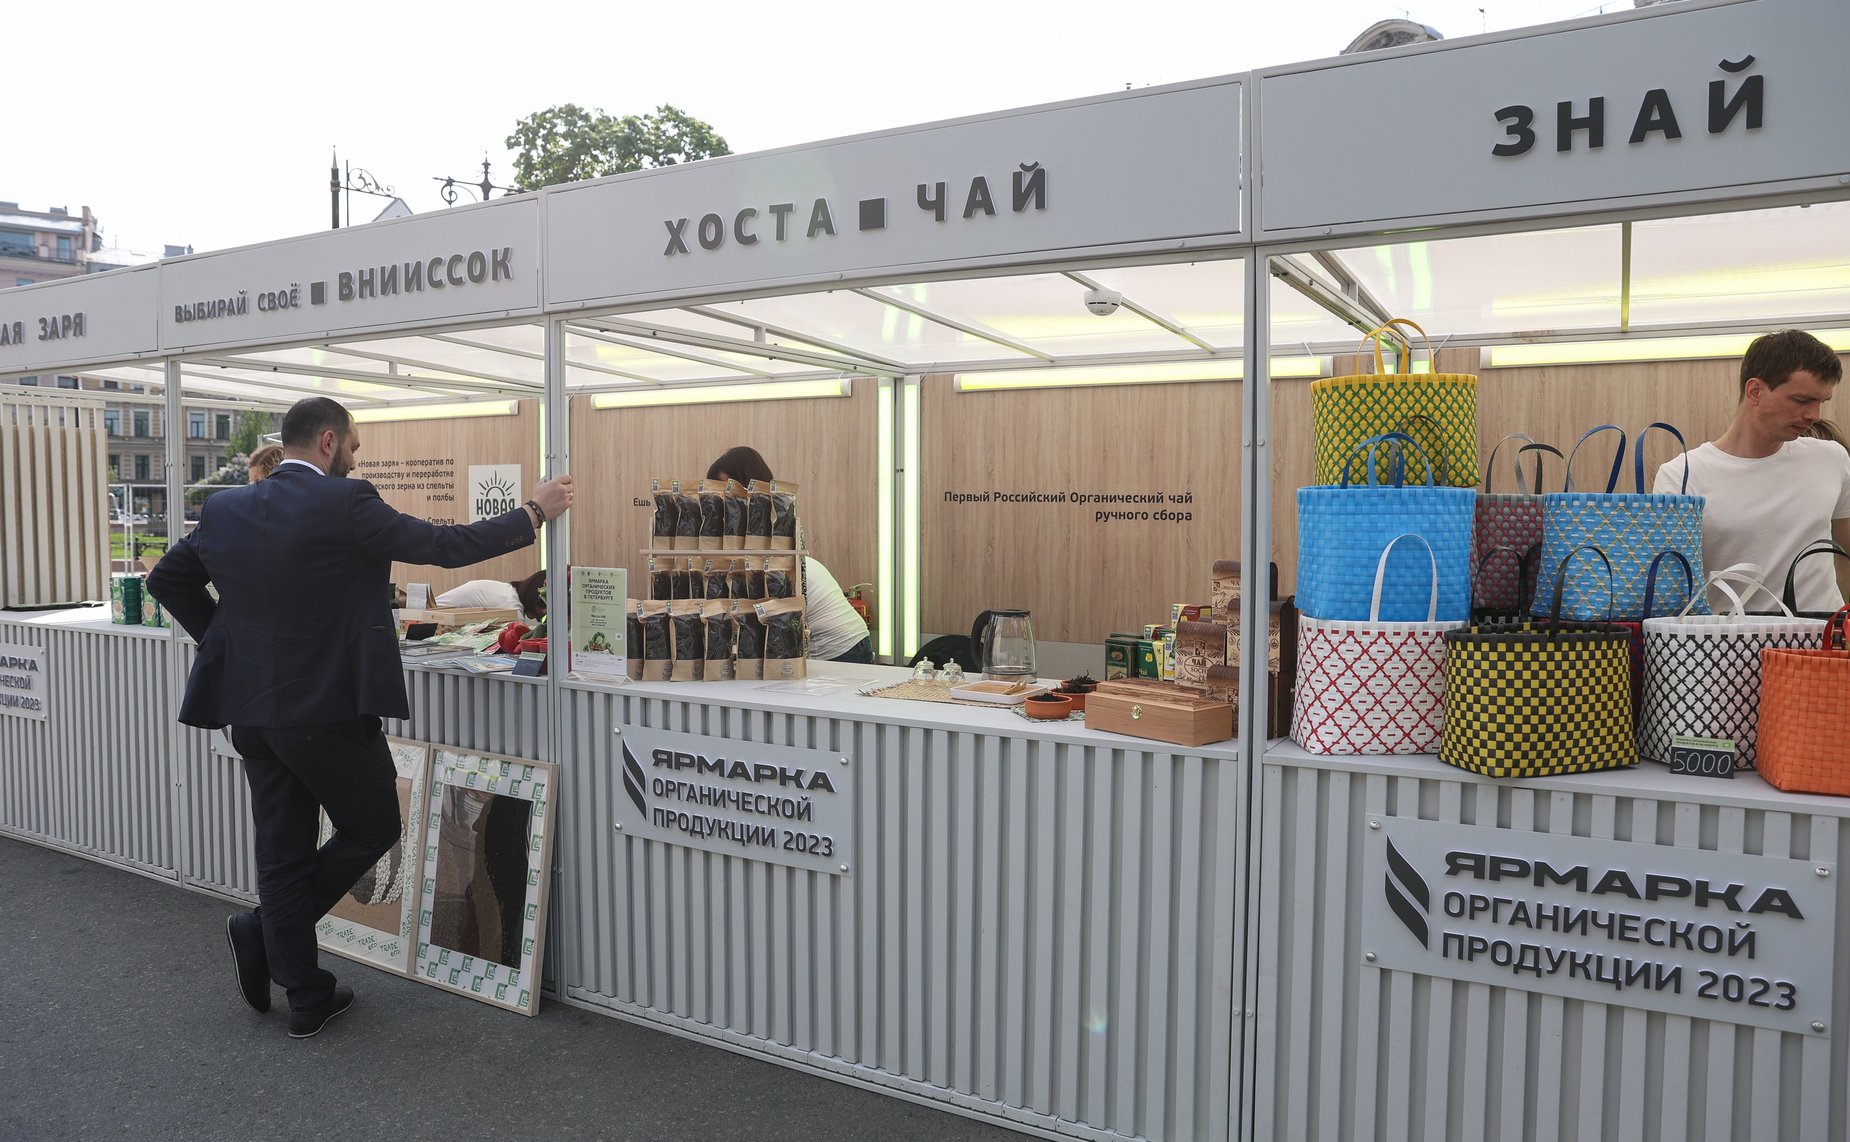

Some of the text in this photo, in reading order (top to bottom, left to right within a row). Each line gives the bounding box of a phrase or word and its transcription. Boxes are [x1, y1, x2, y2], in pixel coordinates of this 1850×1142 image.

[1491, 54, 1765, 157] ЗНАЙ
[663, 160, 1048, 256] ХОСТА ЧАЙ
[174, 246, 513, 323] ВЫБИРАЙ СВОЁ ВНИИССОК
[38, 312, 85, 341] ЗАРЯ
[361, 471, 405, 480] производству
[411, 469, 454, 479] переработке
[405, 459, 444, 467] кооператив
[445, 458, 454, 466] по
[396, 483, 416, 491] зерна
[432, 493, 454, 501] полбы
[944, 490, 1193, 505] Первый Российский Органический чай
[476, 498, 515, 516] НОВАЯ
[633, 497, 651, 507] Ешь
[1095, 509, 1193, 523] ручного сбора
[20, 696, 41, 711] 2023
[652, 748, 837, 793] ЯРМАРКА
[1672, 750, 1731, 775] 5000
[652, 777, 813, 822] ОРГАНИЧЕСКОЙ
[653, 807, 834, 858] ПРОДУКЦИИ 2023
[1444, 851, 1805, 920] ЯРМАРКА
[1443, 891, 1756, 960] ОРГАНИЧЕСКОЙ
[1442, 931, 1797, 1011] ПРОДУКЦИИ 2023
